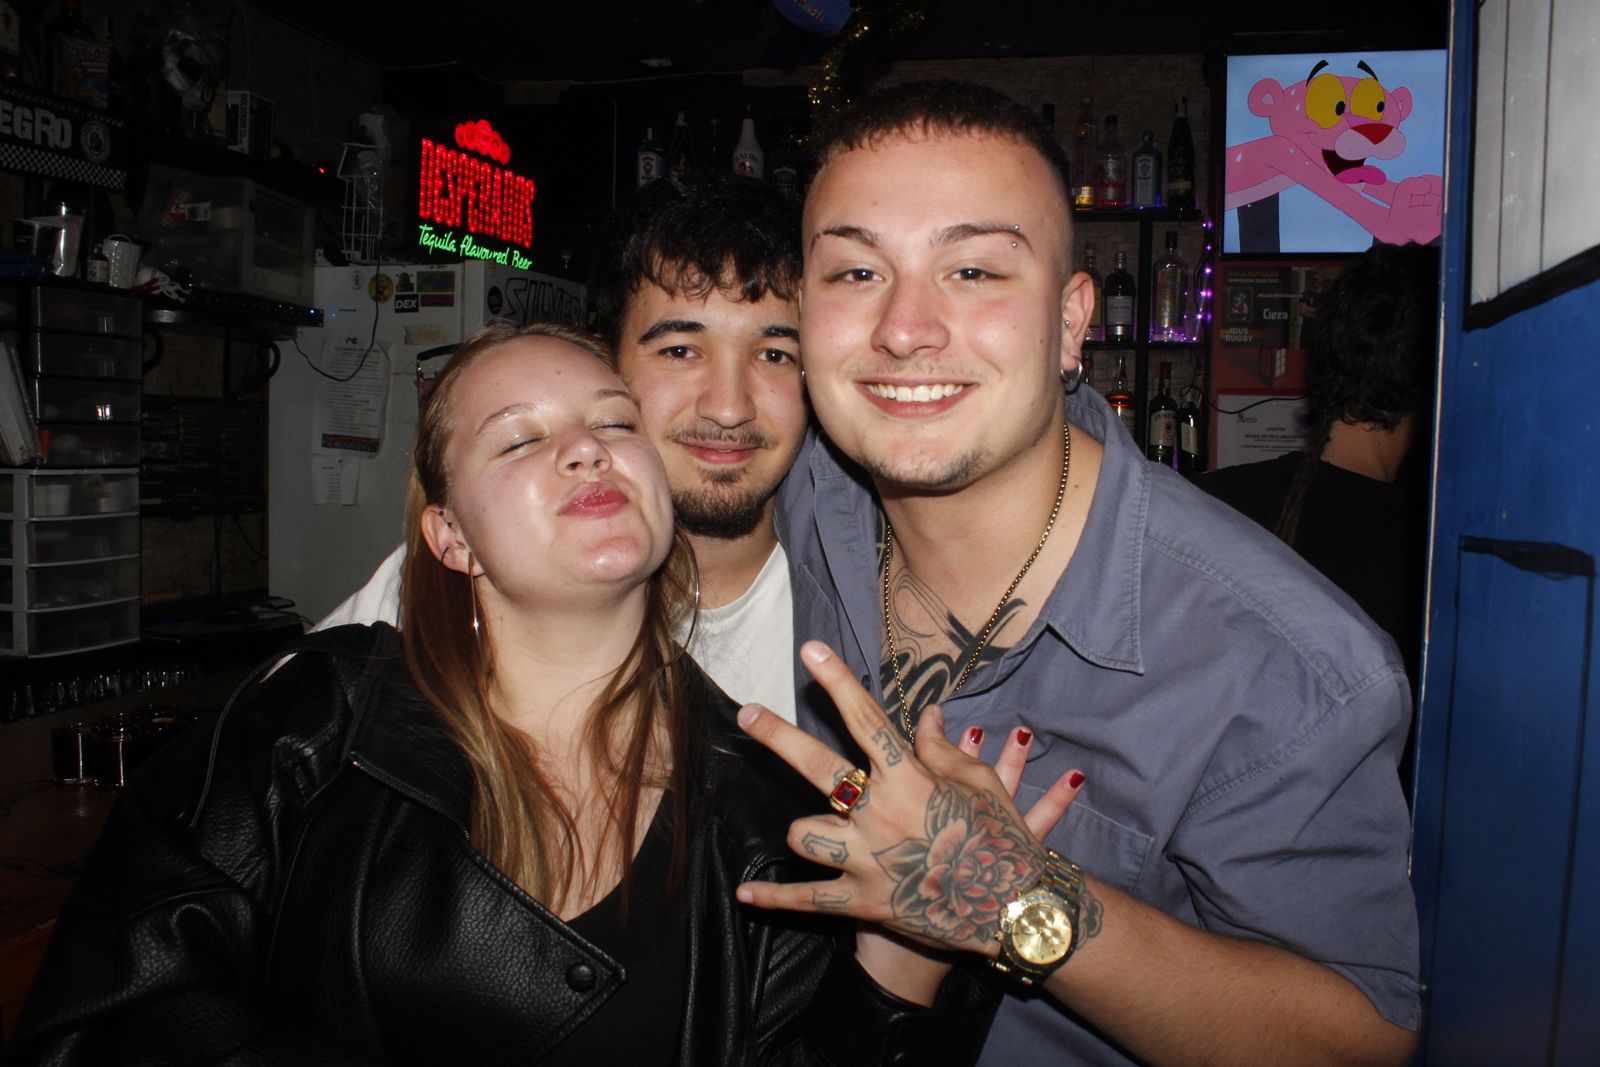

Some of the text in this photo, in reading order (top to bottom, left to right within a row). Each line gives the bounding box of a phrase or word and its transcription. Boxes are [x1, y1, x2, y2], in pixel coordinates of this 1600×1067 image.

[418, 138, 536, 249] DESPERADOS
[418, 223, 533, 270] Tequila flavoured Beer
[395, 299, 418, 309] DEX
[1262, 307, 1289, 320] Cieza
[1225, 334, 1253, 342] RUGBY
